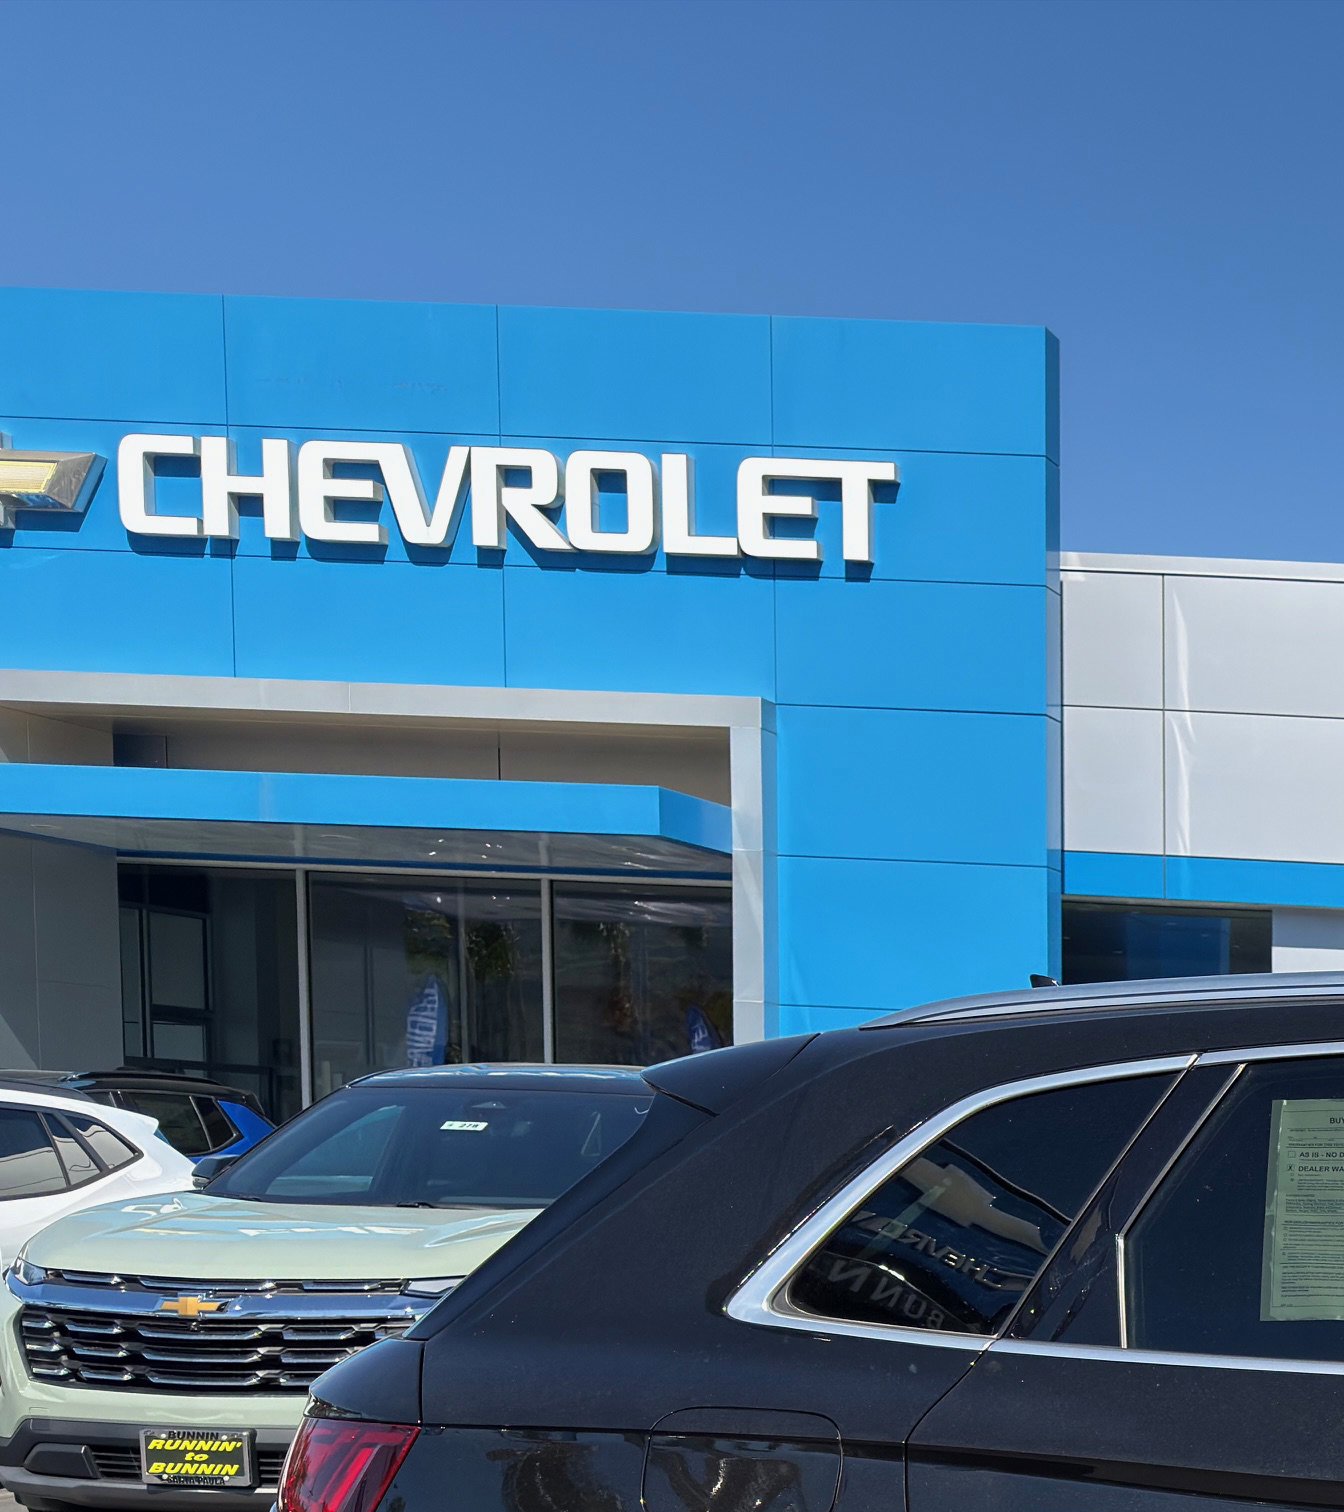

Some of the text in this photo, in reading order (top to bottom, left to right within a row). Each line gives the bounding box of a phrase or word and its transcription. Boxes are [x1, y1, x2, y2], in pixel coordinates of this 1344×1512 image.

[119, 433, 899, 563] CHEVROLET
[1299, 1151, 1310, 1159] AS
[1311, 1151, 1320, 1159] IS
[1325, 1151, 1338, 1159] NO
[1298, 1165, 1330, 1173] DEALER
[168, 1430, 219, 1440] BUNNIN
[147, 1439, 243, 1452] RUNNIN'
[184, 1452, 209, 1461] to
[148, 1462, 240, 1475] BUNNIN
